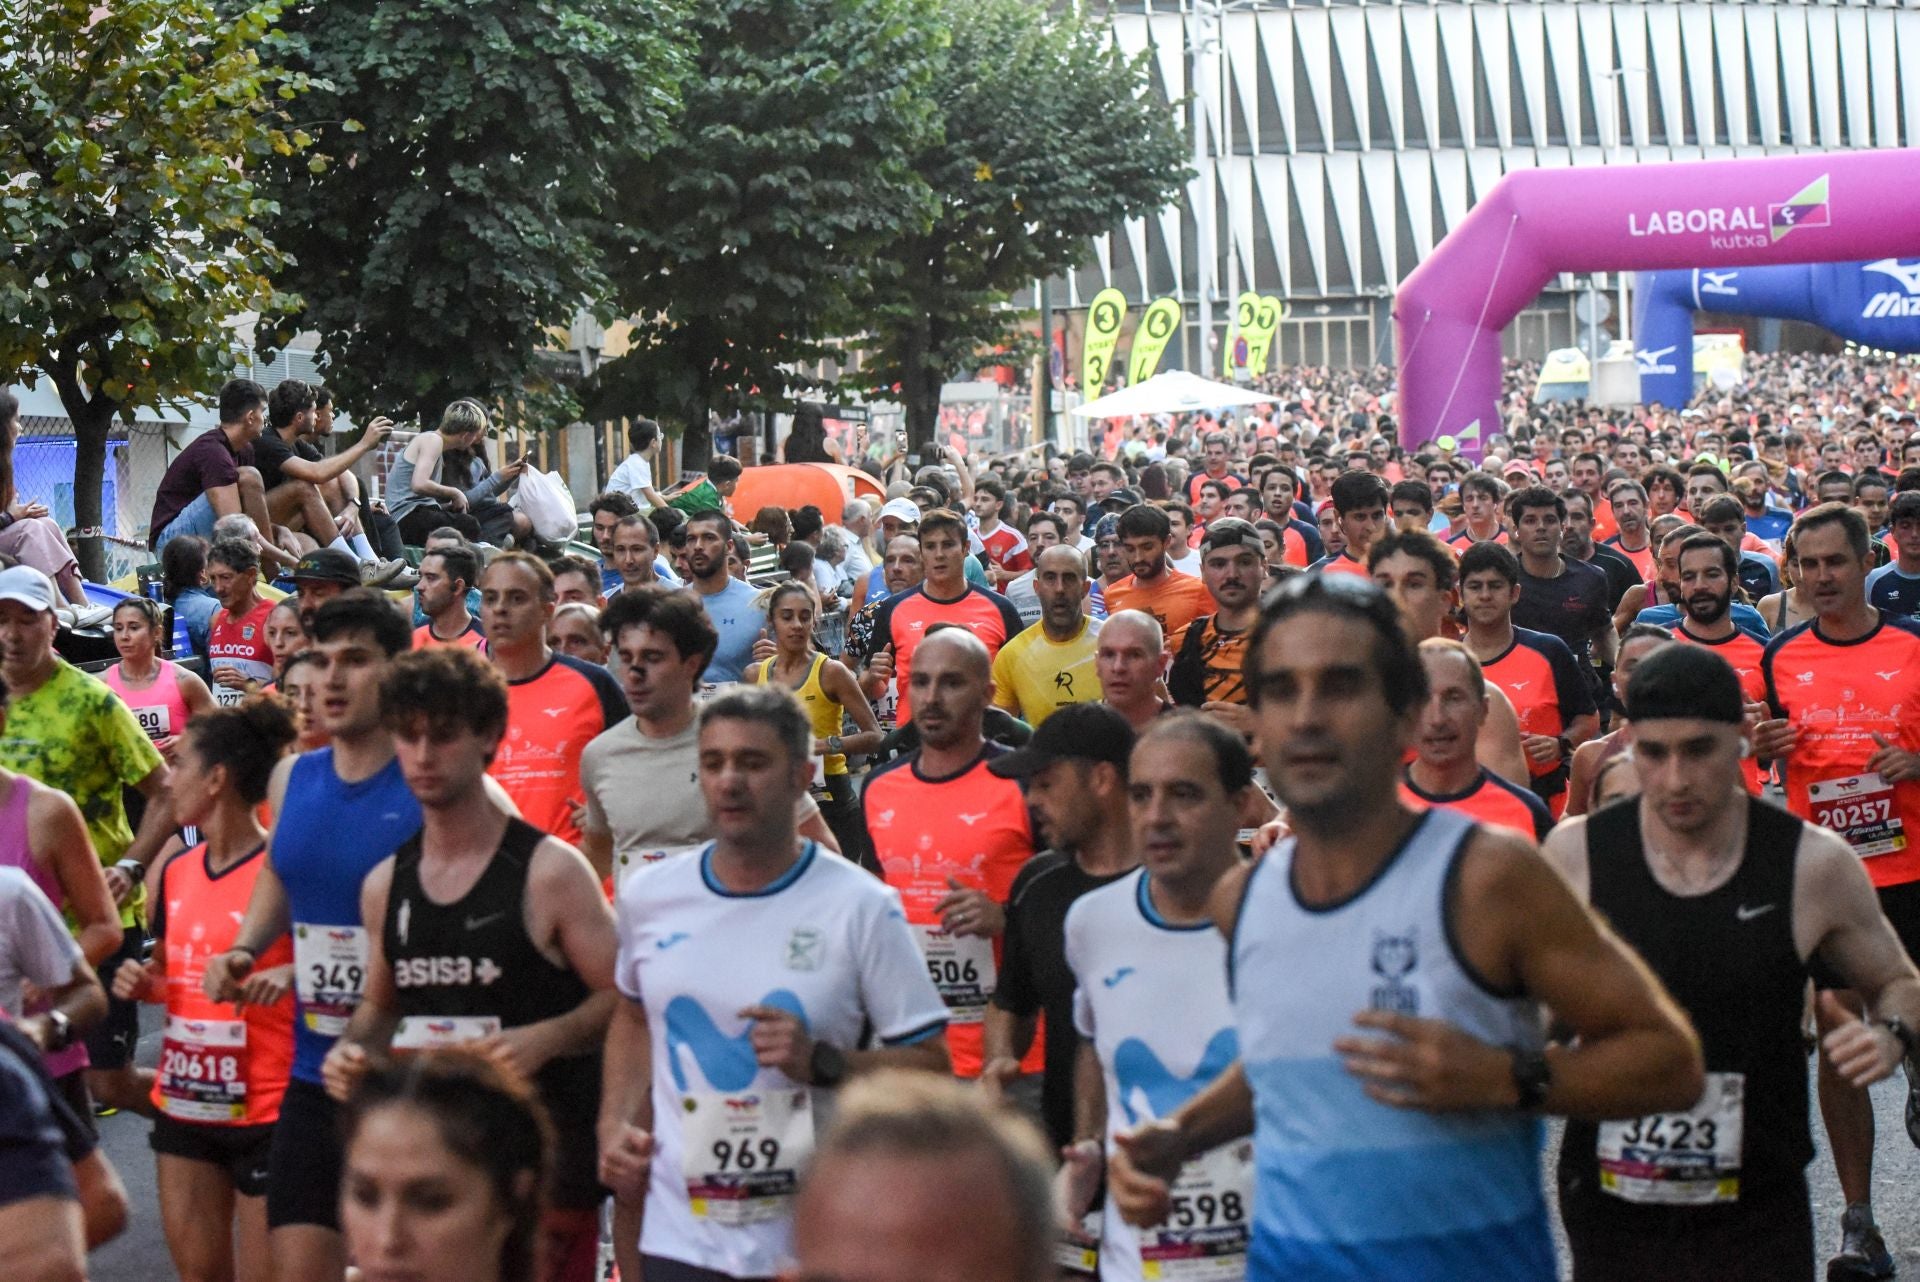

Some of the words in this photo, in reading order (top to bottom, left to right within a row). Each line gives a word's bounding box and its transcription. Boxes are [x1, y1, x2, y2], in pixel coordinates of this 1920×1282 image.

[1629, 206, 1764, 236] LABORAL
[1710, 232, 1767, 250] kutxa
[1089, 355, 1102, 386] 3
[1818, 799, 1891, 829] 20257
[312, 964, 362, 990] 349
[394, 956, 472, 987] asisa
[164, 1048, 238, 1082] 20618
[1623, 1116, 1716, 1149] 3423
[713, 1138, 779, 1170] 969
